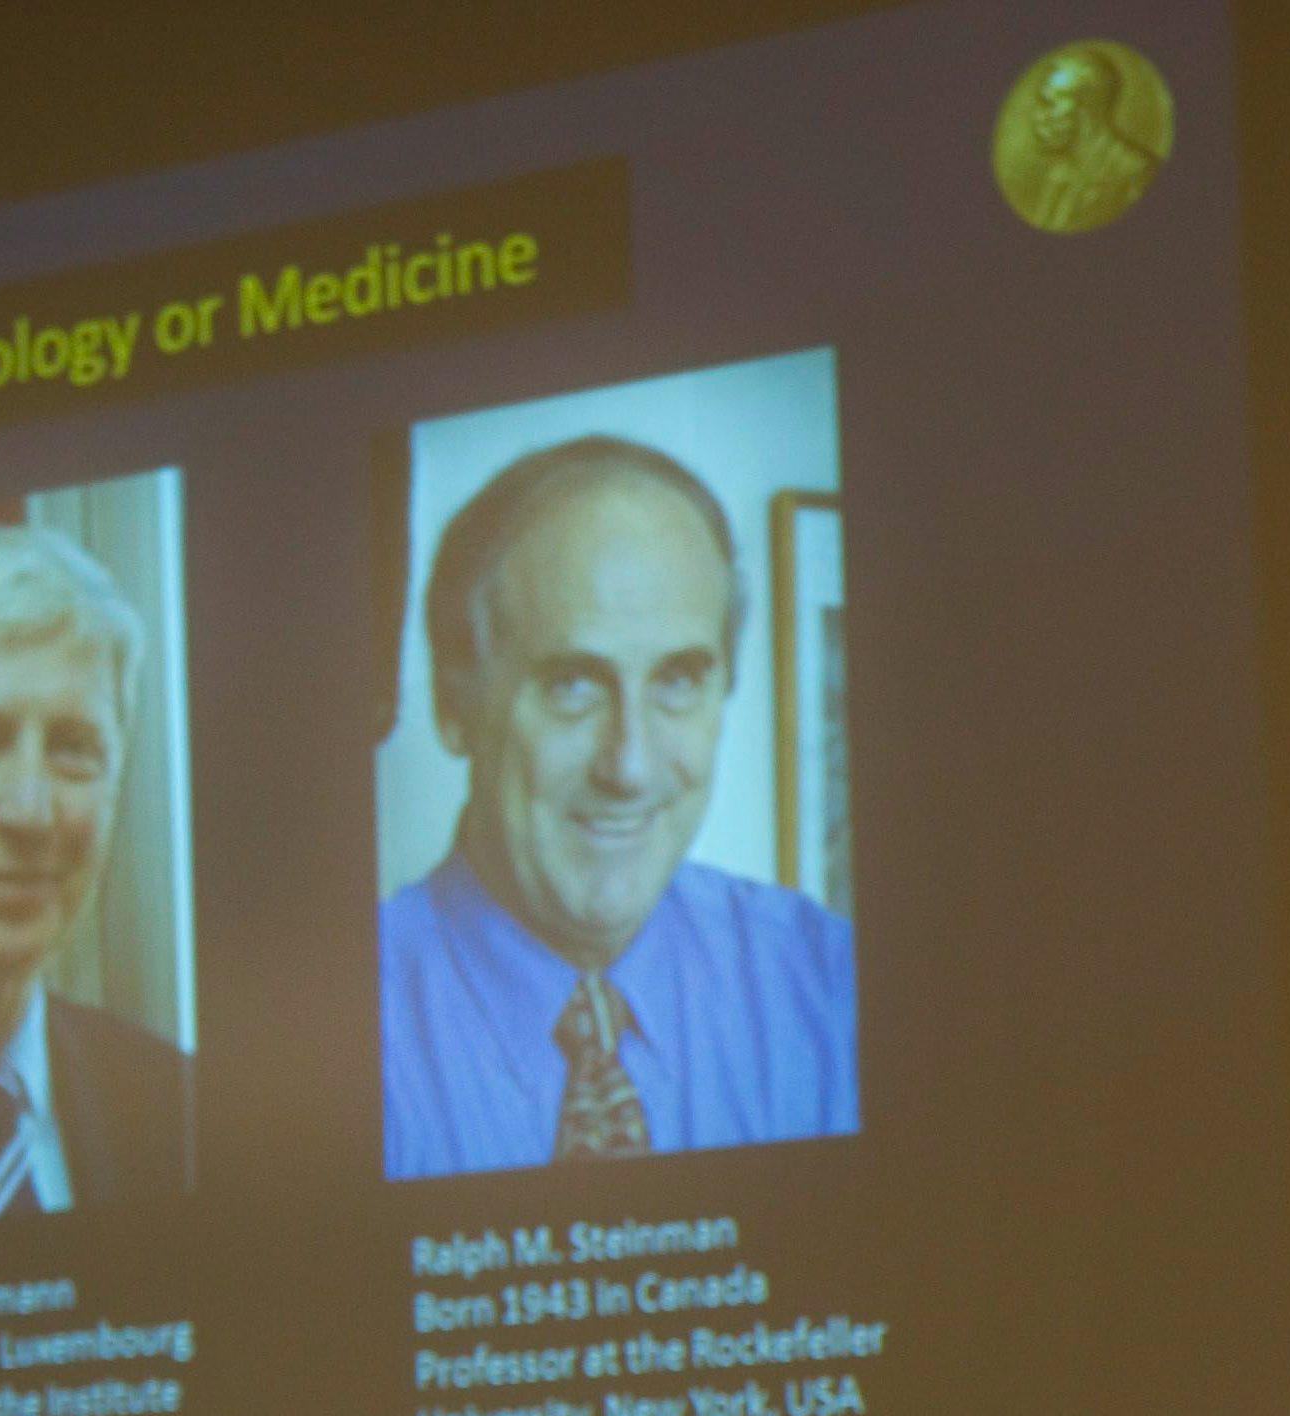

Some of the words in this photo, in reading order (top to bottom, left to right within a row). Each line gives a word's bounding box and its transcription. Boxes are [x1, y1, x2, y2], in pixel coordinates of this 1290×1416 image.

[154, 294, 224, 354] or
[239, 232, 539, 338] Medicine
[411, 1229, 508, 1279] Ralph
[513, 1224, 562, 1266] M.
[567, 1216, 738, 1262] Steinman
[413, 1291, 496, 1333] Born
[501, 1277, 590, 1325] 1943
[595, 1279, 630, 1316] in
[634, 1264, 768, 1314] Canada
[415, 1341, 577, 1389] Professor
[581, 1340, 621, 1378] at
[624, 1331, 686, 1375] the
[690, 1315, 889, 1369] Rockefeller
